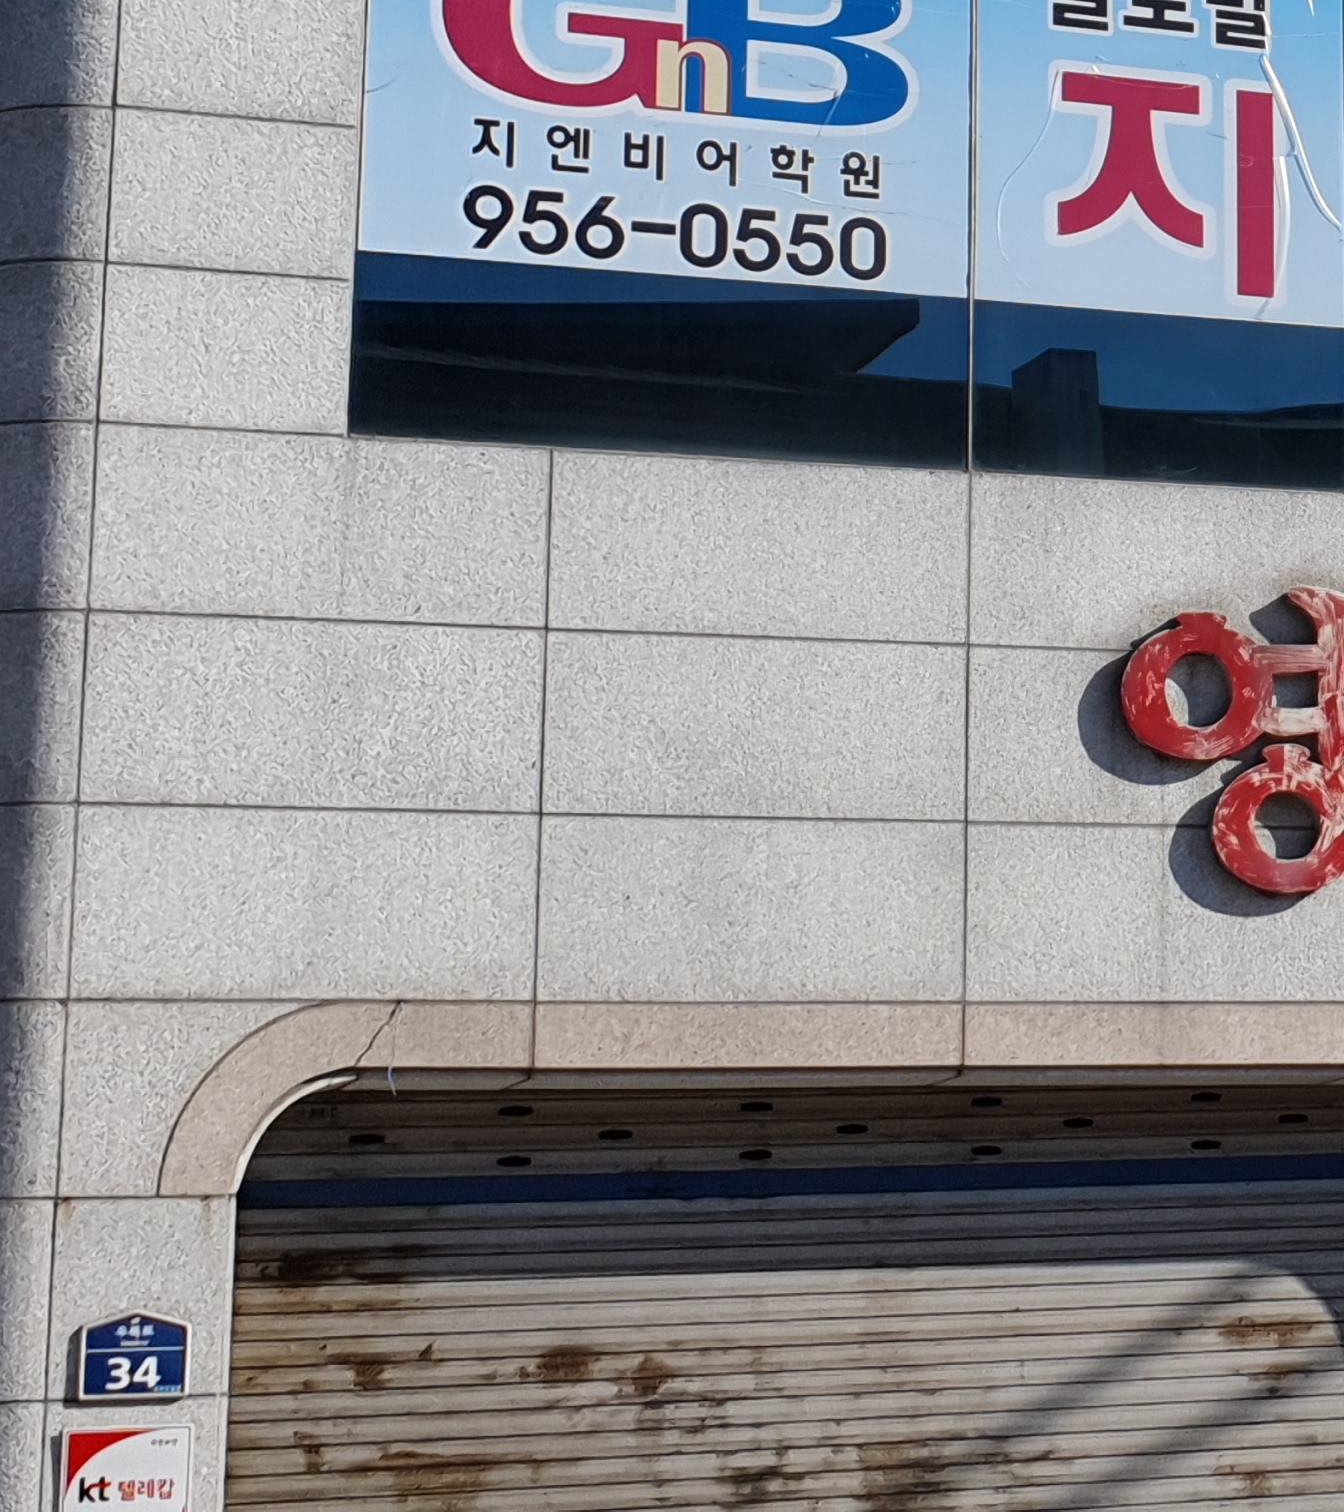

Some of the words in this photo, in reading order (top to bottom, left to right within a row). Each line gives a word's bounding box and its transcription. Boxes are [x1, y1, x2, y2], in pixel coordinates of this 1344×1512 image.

[472, 118, 880, 198] 지엔비어학원
[462, 184, 888, 281] 956-0550
[105, 1356, 161, 1391] 34
[78, 1477, 111, 1503] kt
[118, 1478, 175, 1501] 텔레캅
